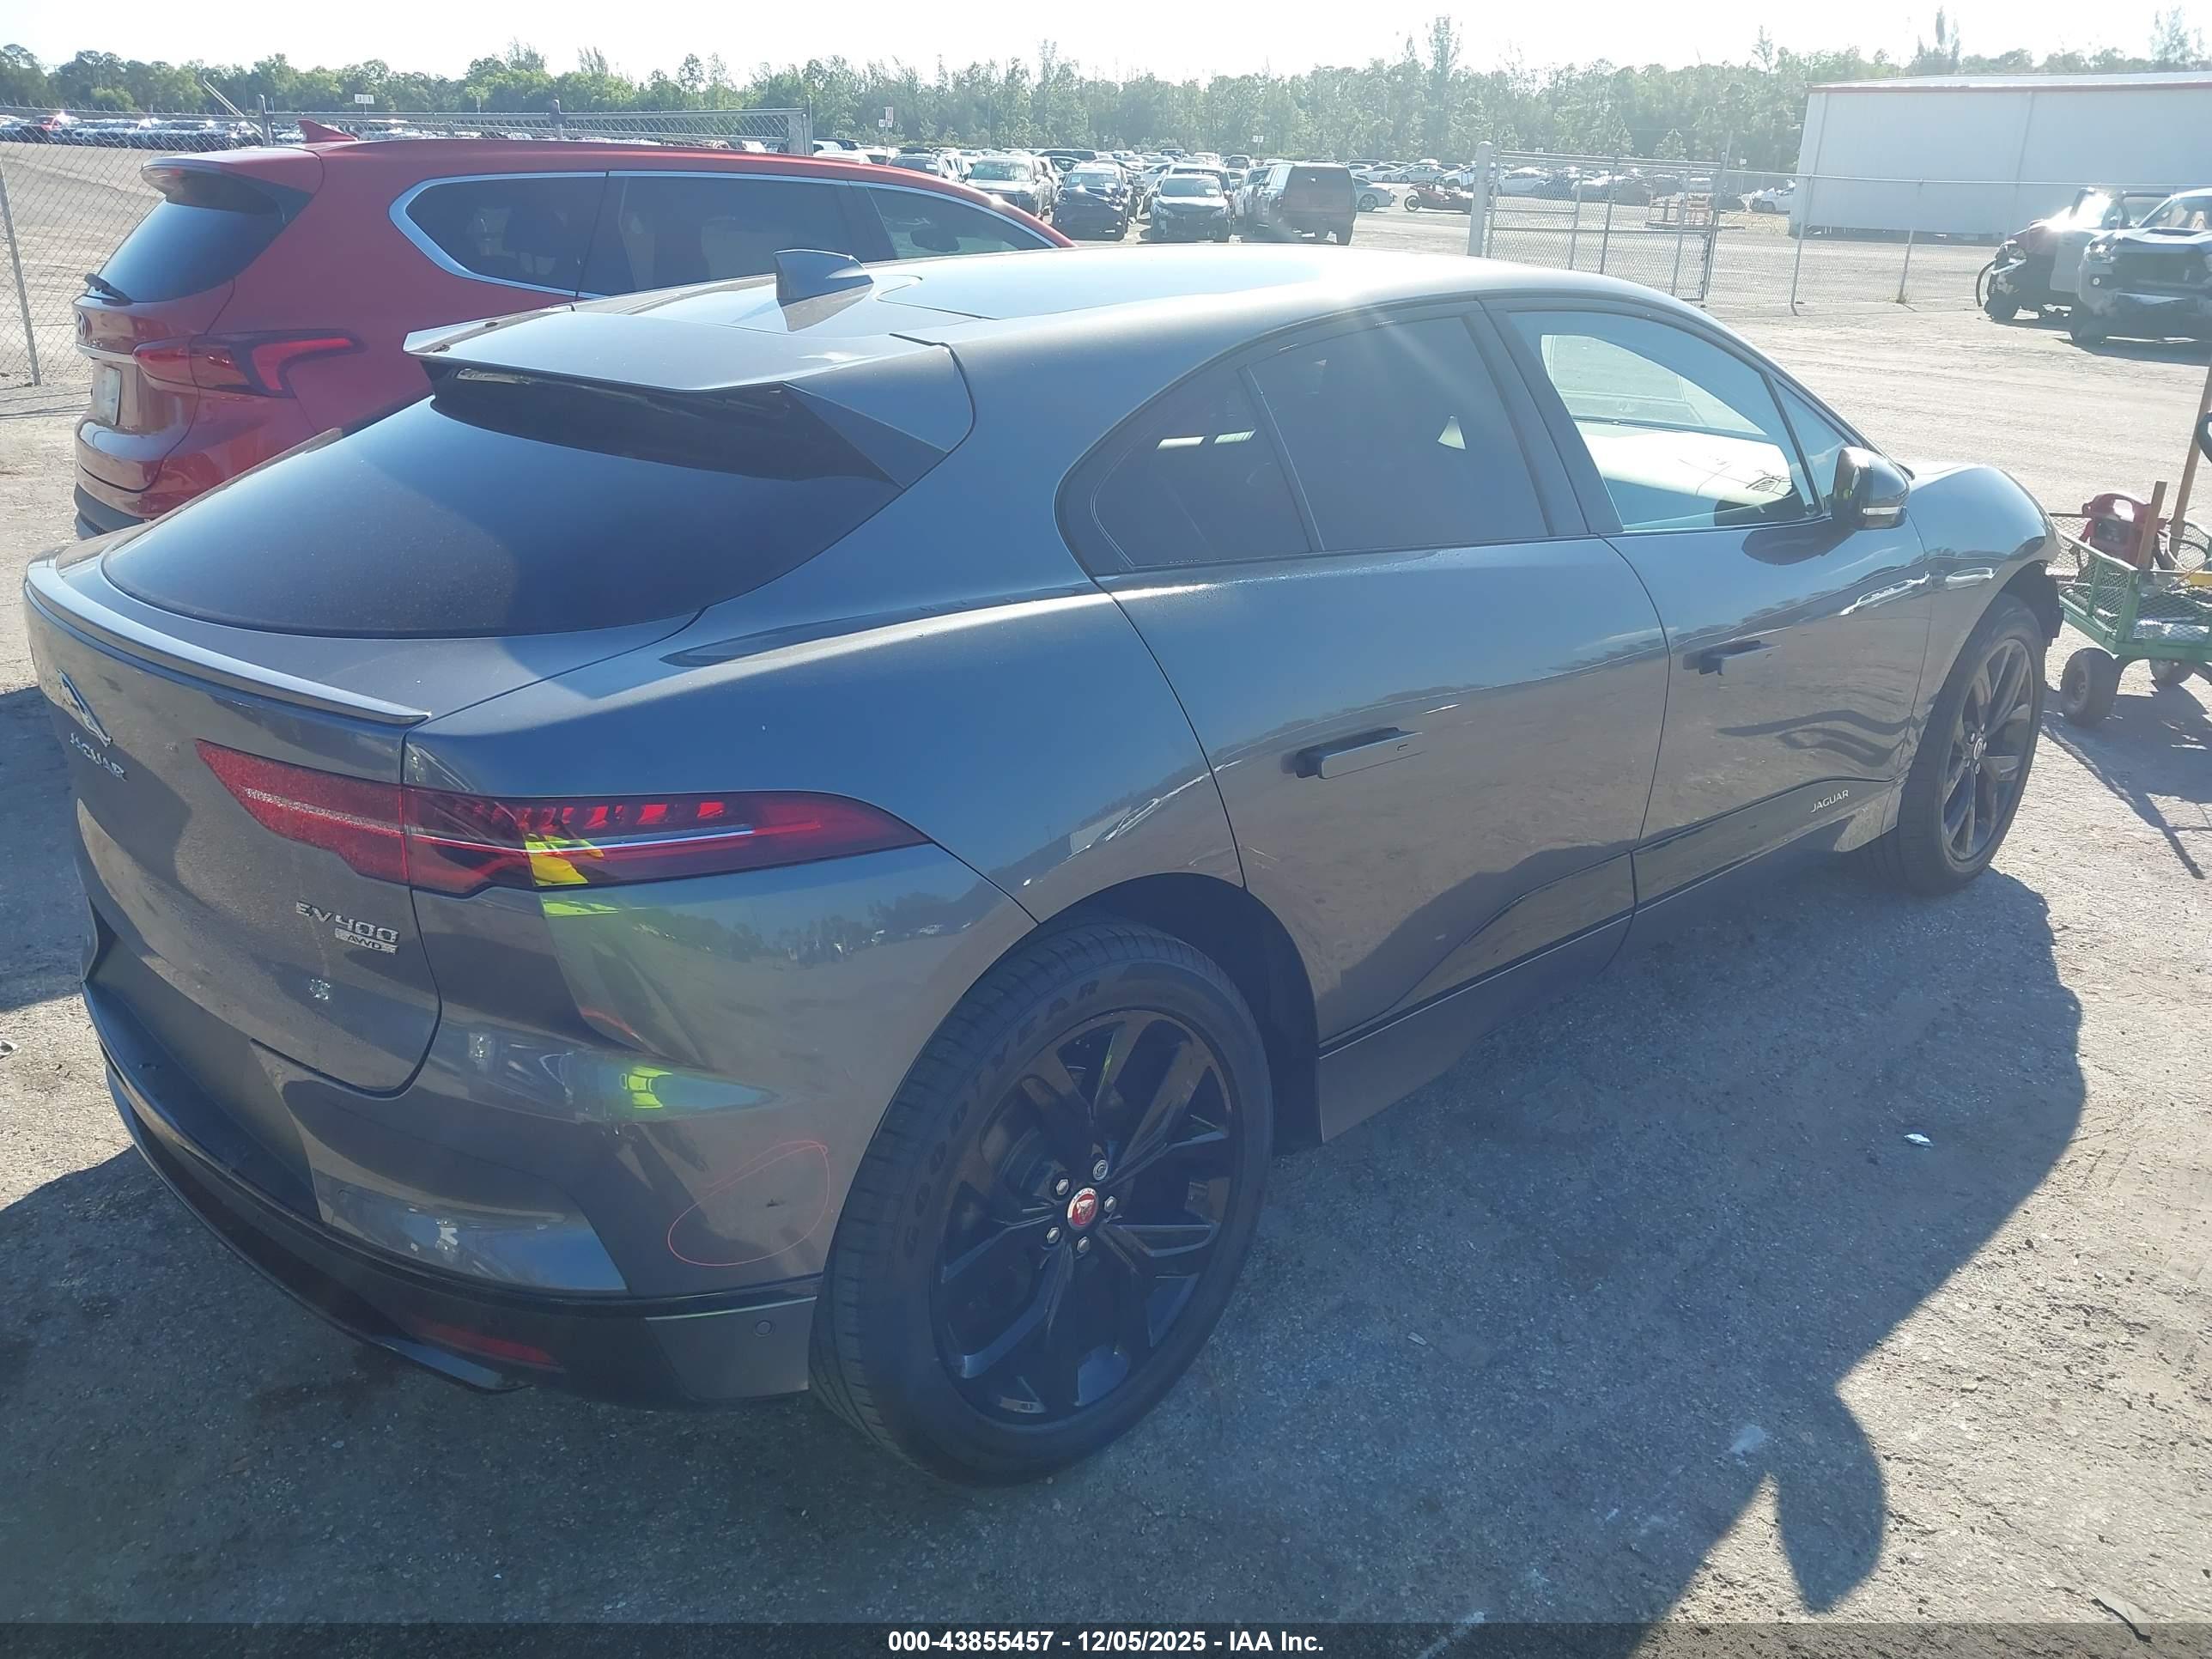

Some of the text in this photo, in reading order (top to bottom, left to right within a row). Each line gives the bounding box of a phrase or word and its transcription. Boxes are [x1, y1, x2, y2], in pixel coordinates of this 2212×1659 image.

[70, 732, 127, 781] JAGUAR
[1810, 790, 1849, 812] JAGUAR
[295, 901, 399, 943] EV400
[348, 934, 381, 950] AWD
